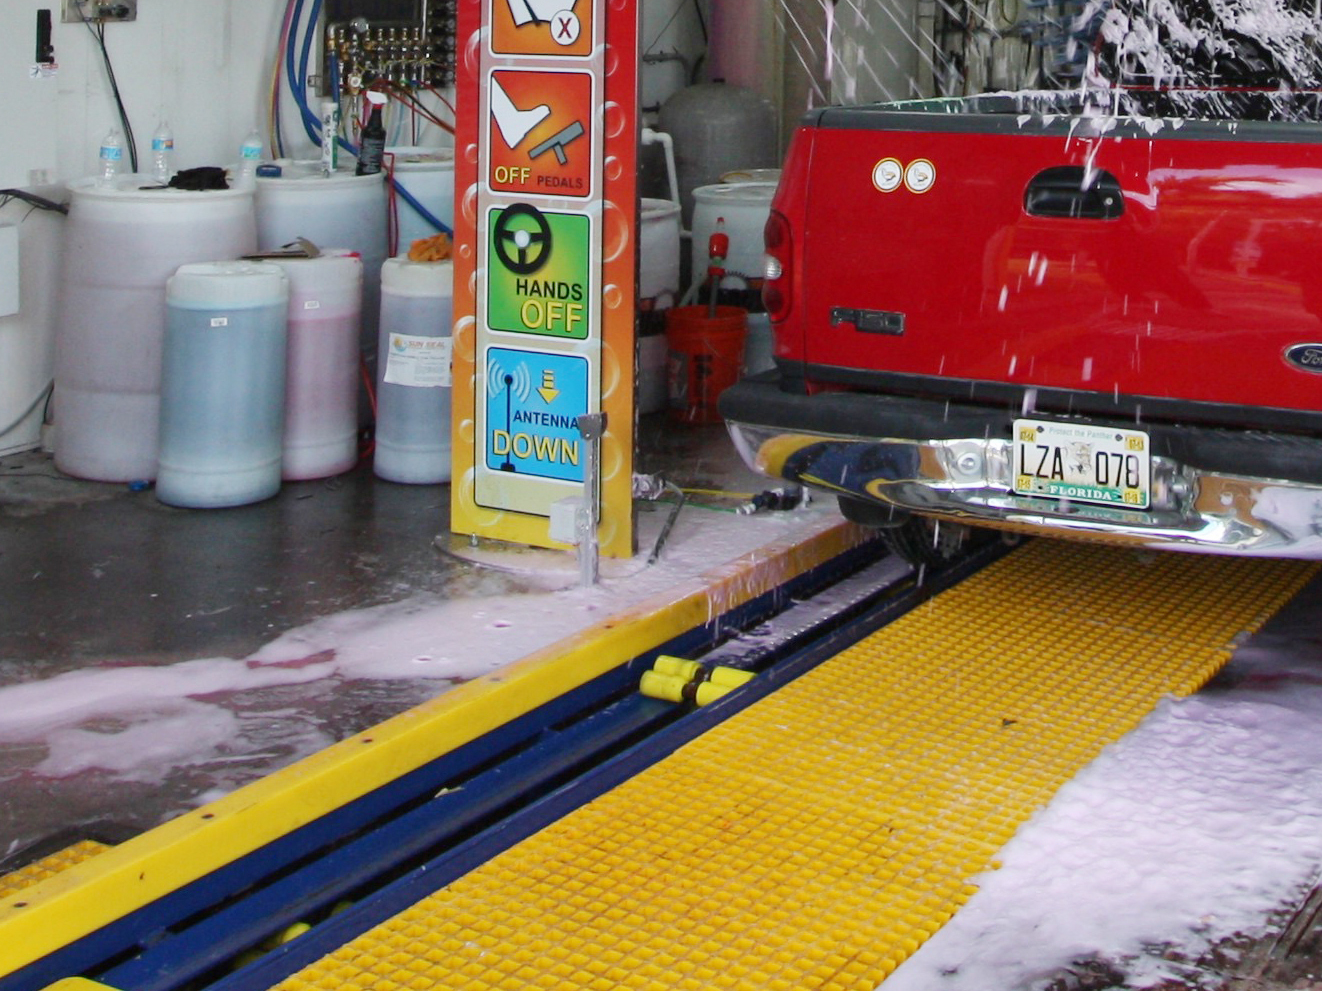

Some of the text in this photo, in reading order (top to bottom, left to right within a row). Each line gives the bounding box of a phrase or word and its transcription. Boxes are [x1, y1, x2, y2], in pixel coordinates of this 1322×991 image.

[494, 165, 583, 189] OFF PEDALS
[516, 278, 583, 302] HANDS
[520, 299, 583, 332] OFF
[513, 409, 579, 430] ANTENNA
[492, 429, 579, 466] DOWN
[1020, 443, 1140, 489] LZA 078
[1050, 485, 1112, 501] FLORIDA
